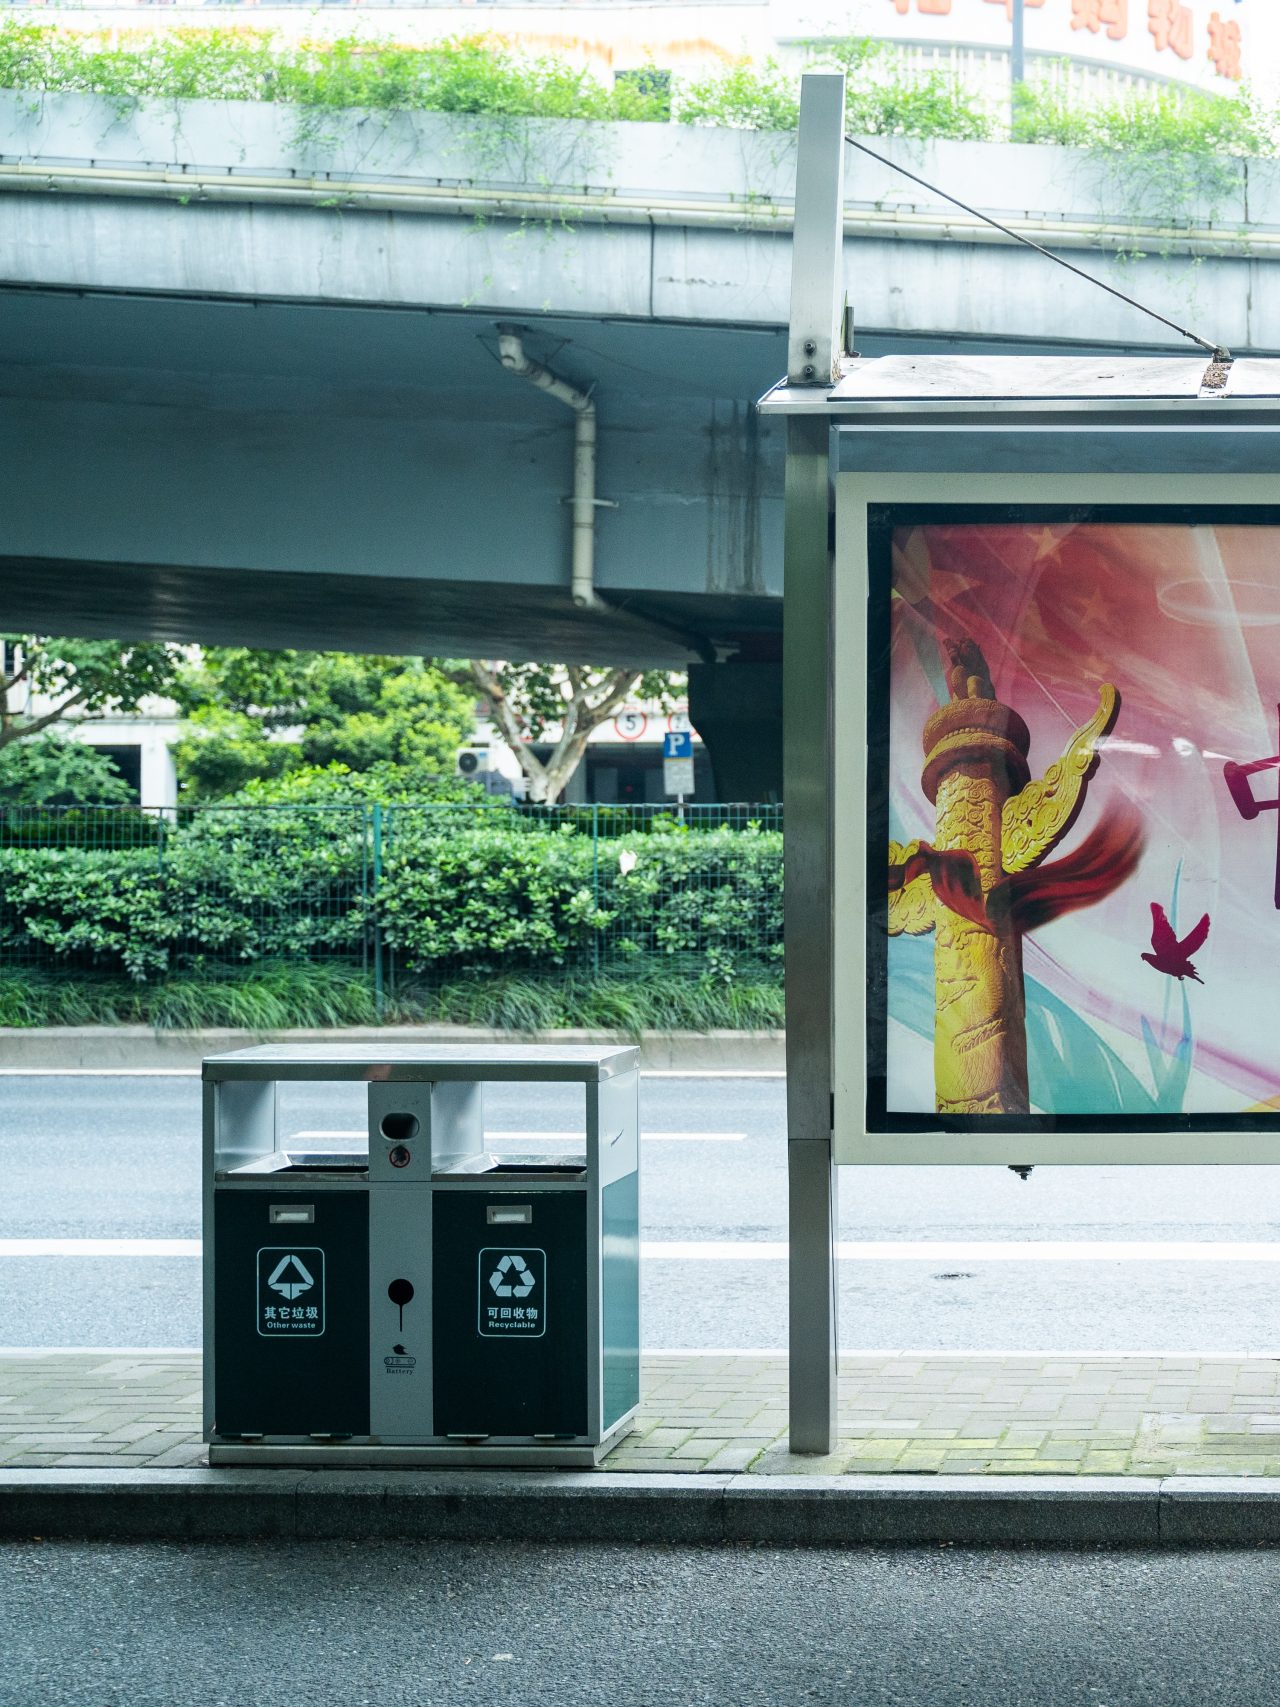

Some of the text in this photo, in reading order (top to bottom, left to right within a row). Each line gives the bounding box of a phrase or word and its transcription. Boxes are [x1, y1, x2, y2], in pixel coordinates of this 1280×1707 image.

[668, 734, 685, 756] P
[264, 1306, 319, 1320] 其它垃圾
[487, 1306, 538, 1320] 可回收物
[266, 1321, 316, 1329] Other waste
[488, 1320, 536, 1330] Recyclable
[386, 1368, 414, 1376] Battery
